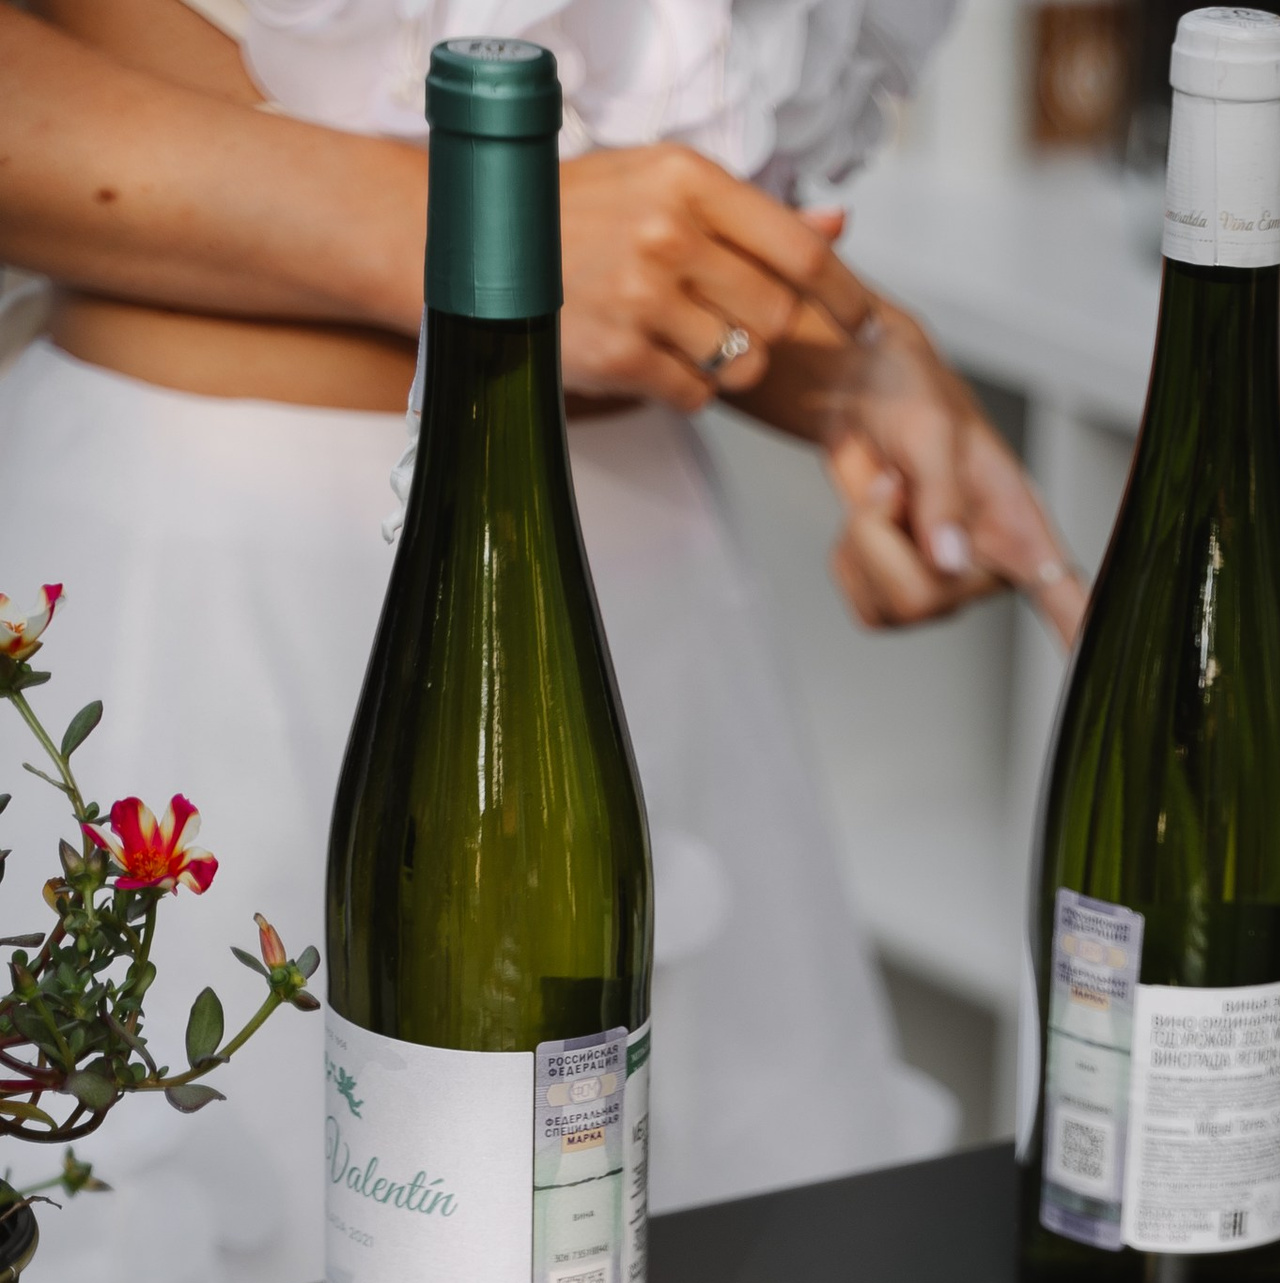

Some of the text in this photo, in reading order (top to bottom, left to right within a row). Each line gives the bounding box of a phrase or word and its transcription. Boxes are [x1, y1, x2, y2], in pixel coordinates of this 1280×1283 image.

[548, 1044, 619, 1067] РОССИЙСКАЯ
[548, 1055, 619, 1077] ФЕДЕРАЦИЯ
[545, 1103, 620, 1127] ФЕДЕРАЛЬНАЯ
[545, 1114, 620, 1138] СПЕЦИАЛЬНАЯ
[566, 1131, 603, 1145] МАРКА
[326, 1115, 459, 1217] Valentín
